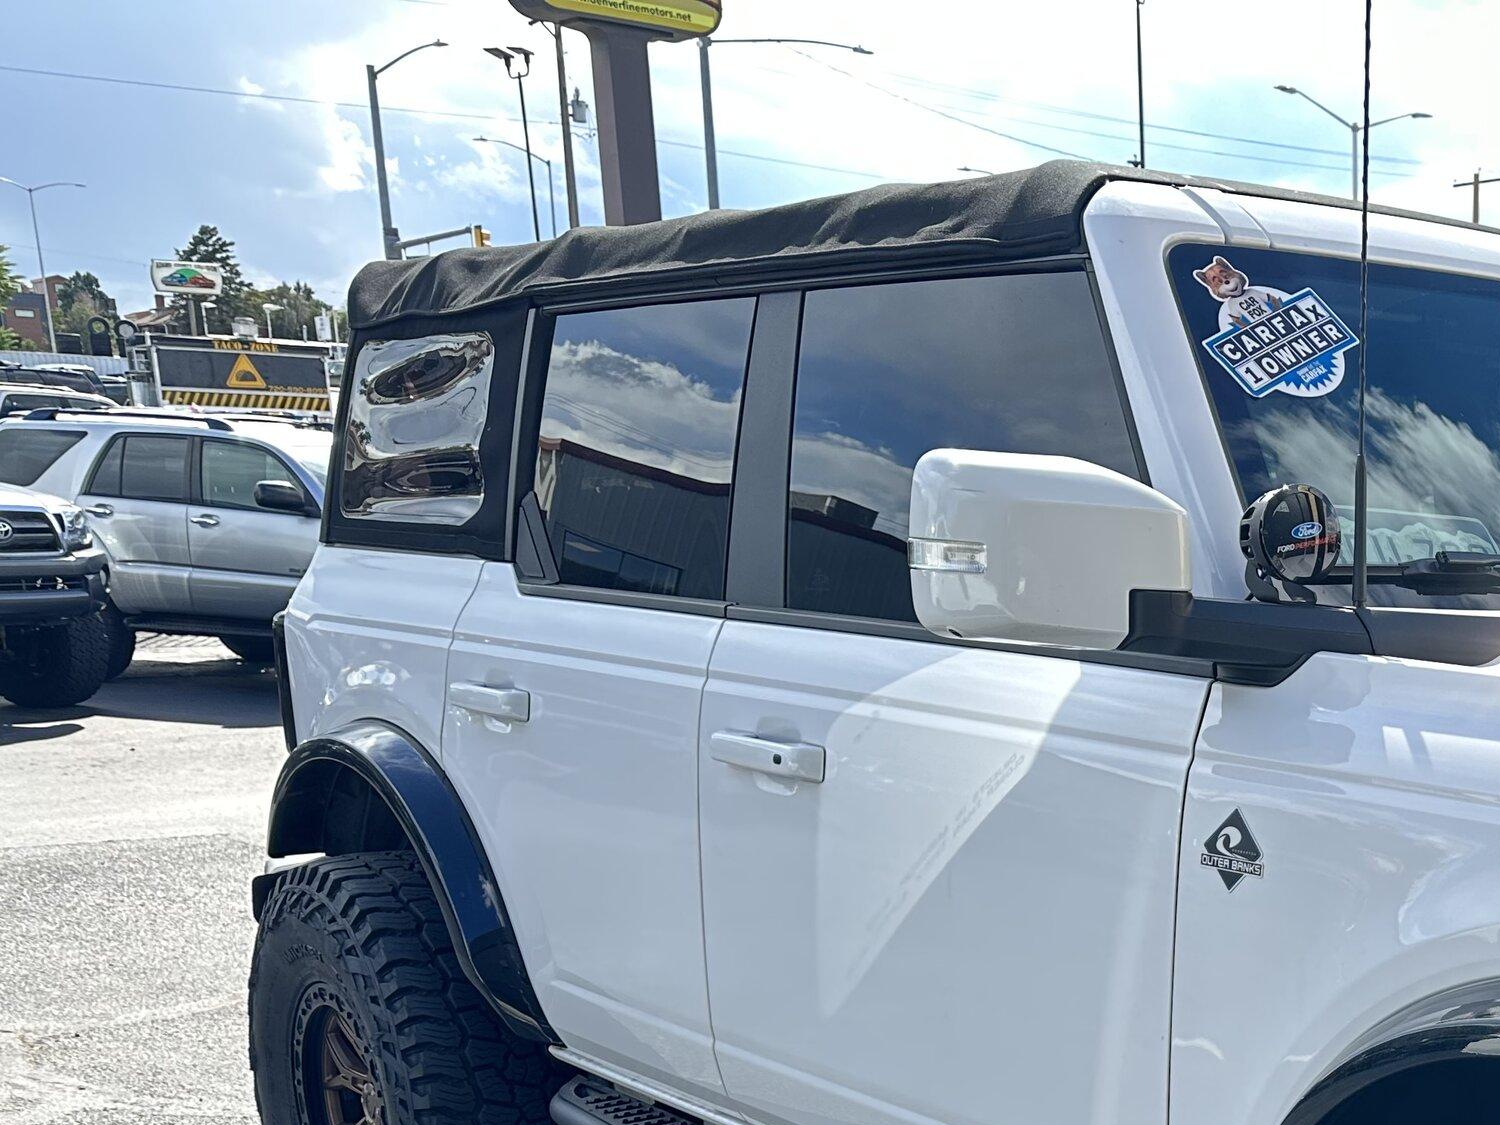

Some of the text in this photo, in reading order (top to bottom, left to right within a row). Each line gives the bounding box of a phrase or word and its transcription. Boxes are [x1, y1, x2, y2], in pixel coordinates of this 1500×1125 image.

[1239, 296, 1259, 310] CAR
[1247, 306, 1267, 320] FOX
[1222, 304, 1324, 360] CARFAX
[1244, 366, 1263, 384] 1
[1261, 323, 1343, 374] OWNER
[1202, 854, 1261, 875] OUTER BANKS
